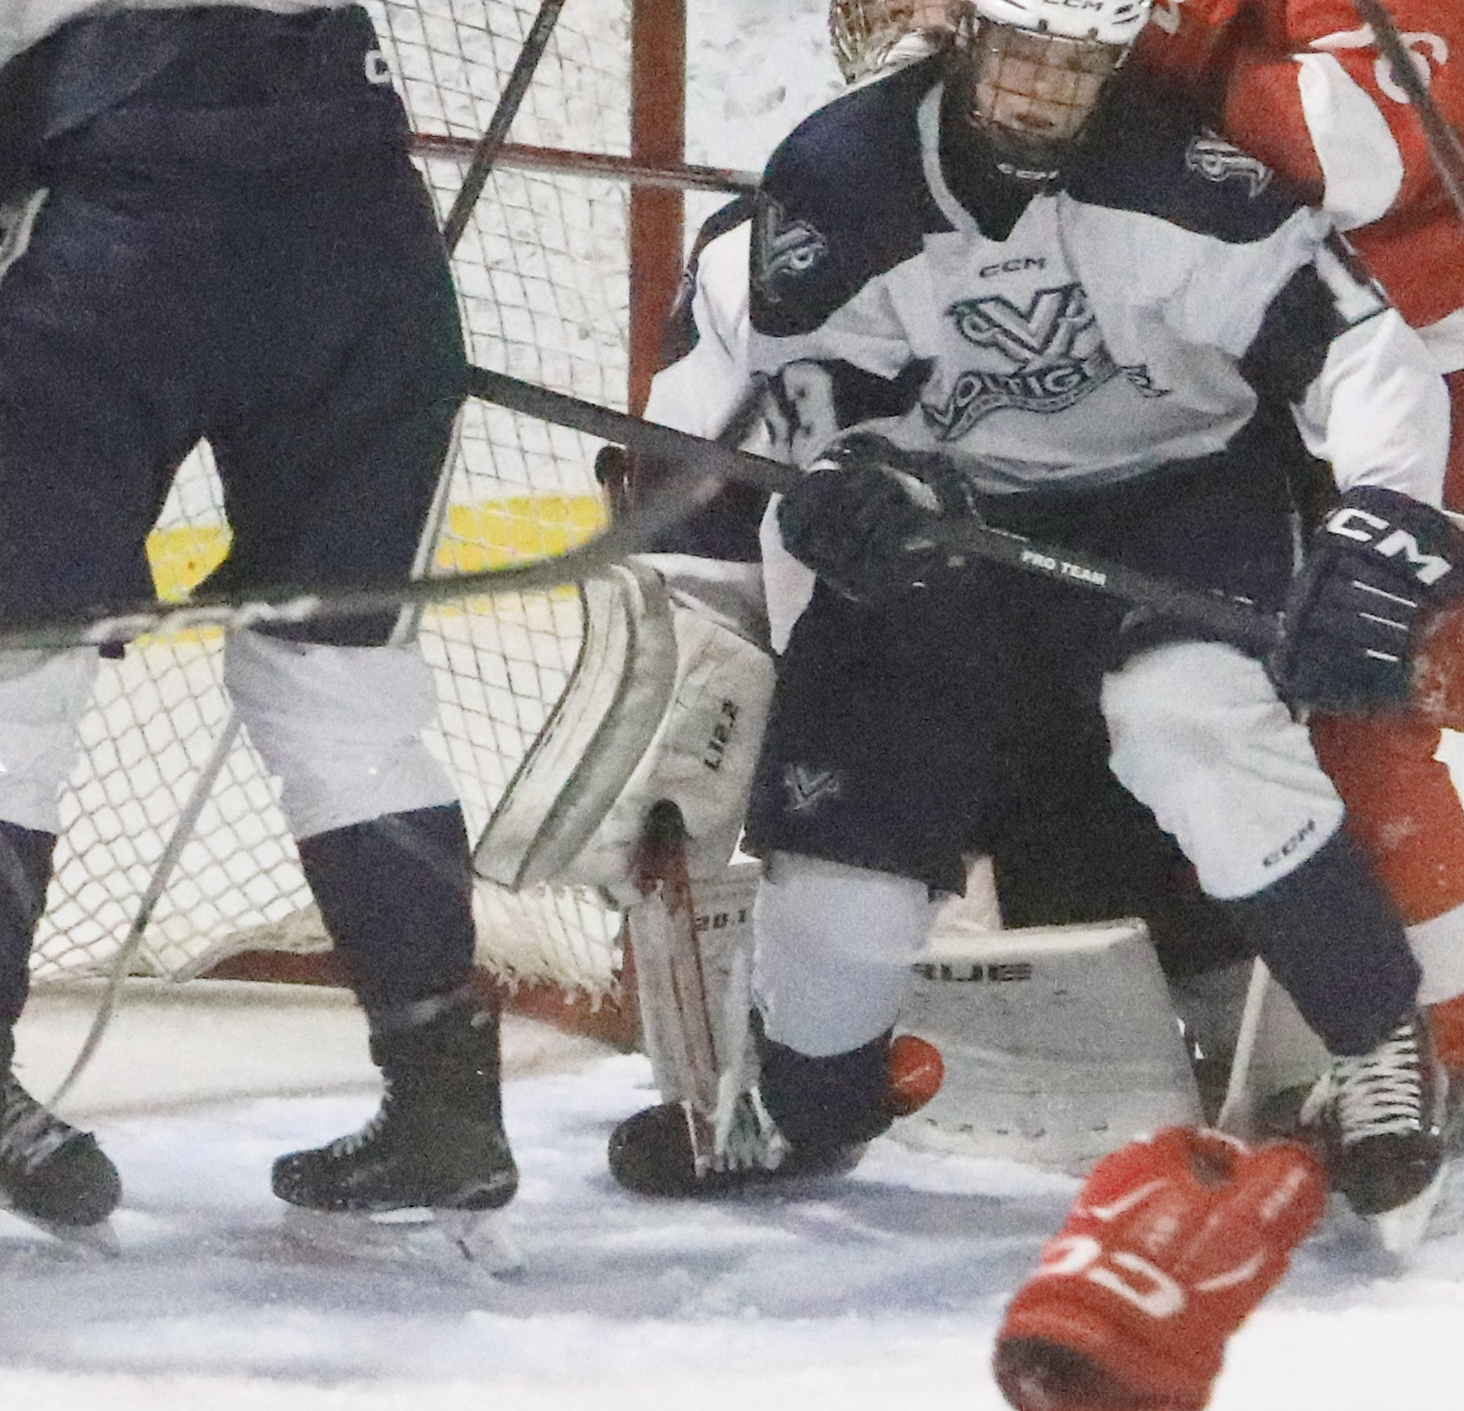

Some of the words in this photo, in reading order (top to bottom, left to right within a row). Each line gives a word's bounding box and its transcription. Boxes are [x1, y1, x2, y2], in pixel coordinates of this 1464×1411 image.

[979, 257, 1046, 278] CCM
[1325, 506, 1453, 587] CM
[1021, 549, 1057, 573] PRO
[1059, 561, 1107, 587] TEAM
[1261, 818, 1317, 869] CCM
[911, 960, 1032, 983] RUE
